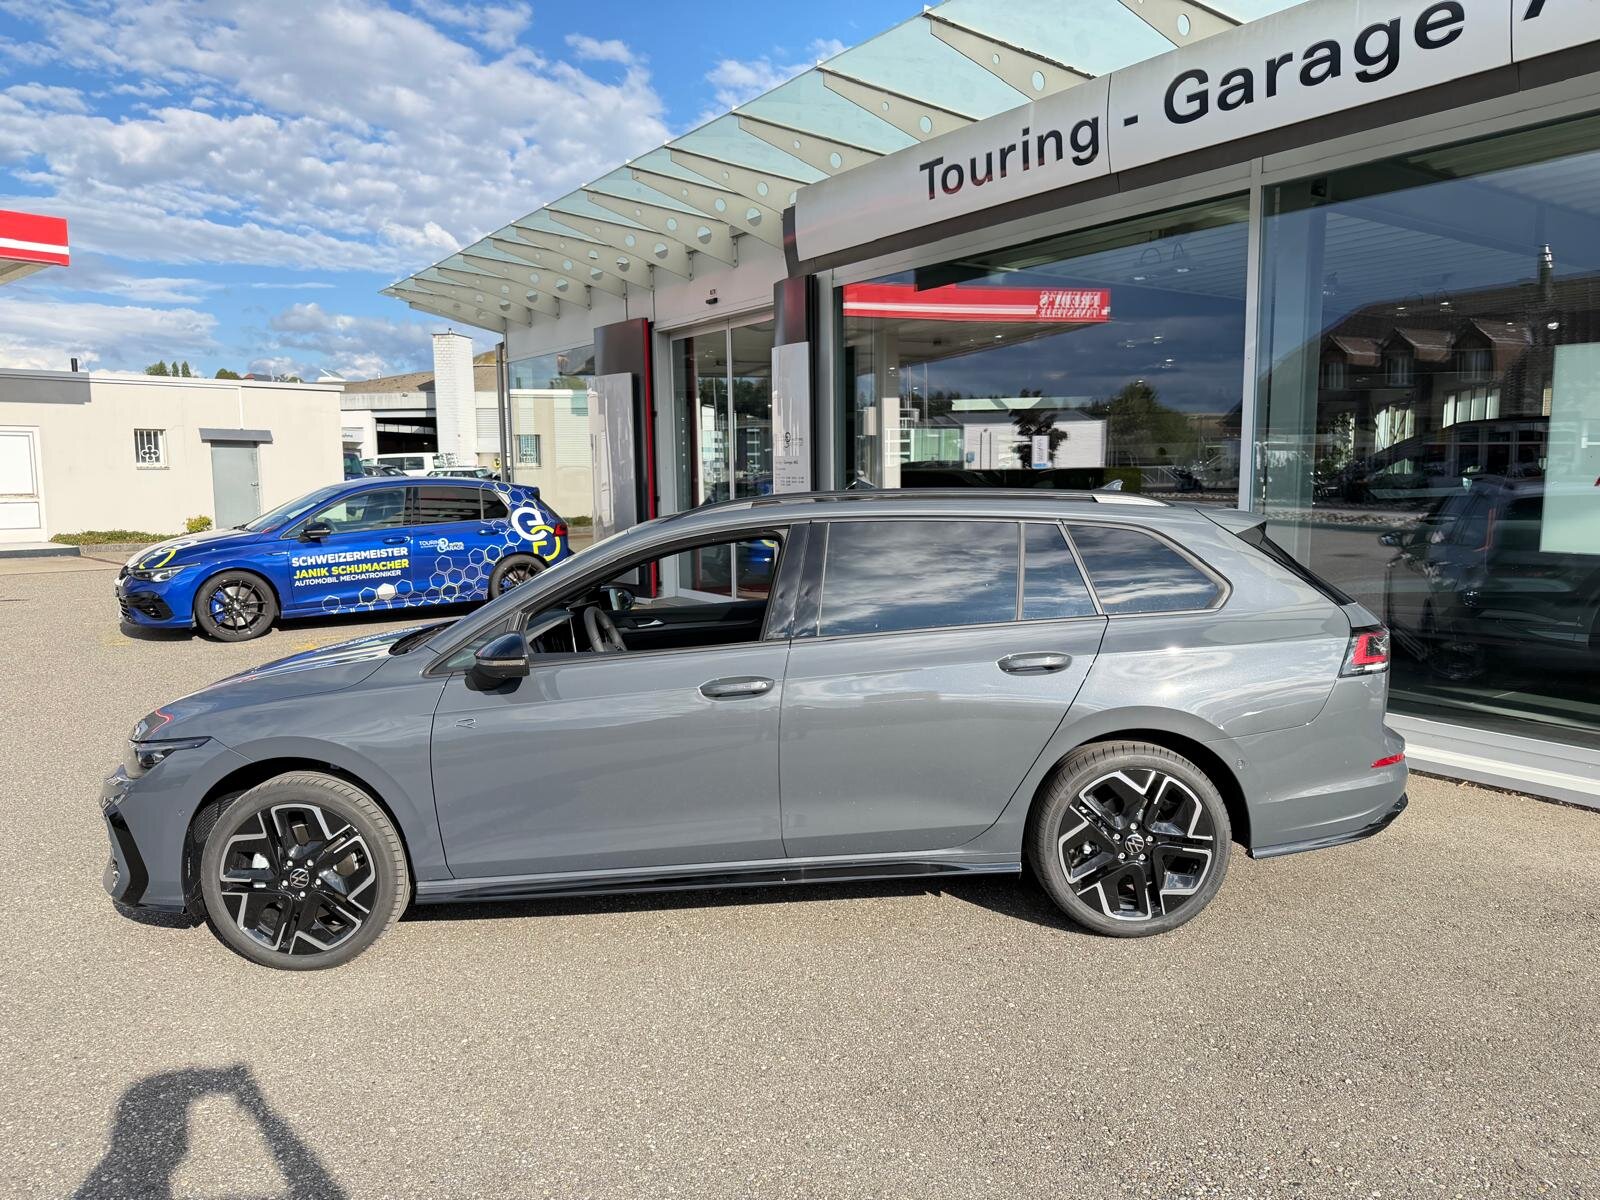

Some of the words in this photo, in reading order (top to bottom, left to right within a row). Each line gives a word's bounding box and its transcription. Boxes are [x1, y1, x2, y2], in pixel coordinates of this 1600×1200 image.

[919, 113, 1100, 199] Touring
[1163, 0, 1465, 126] Garage
[291, 547, 408, 567] SCHWEIZERMEISTER
[294, 567, 329, 579] JANIK
[331, 559, 409, 575] SCHUMACHER
[294, 577, 339, 587] AUTOMOBIL
[340, 570, 401, 582] MECHATRONIKER
